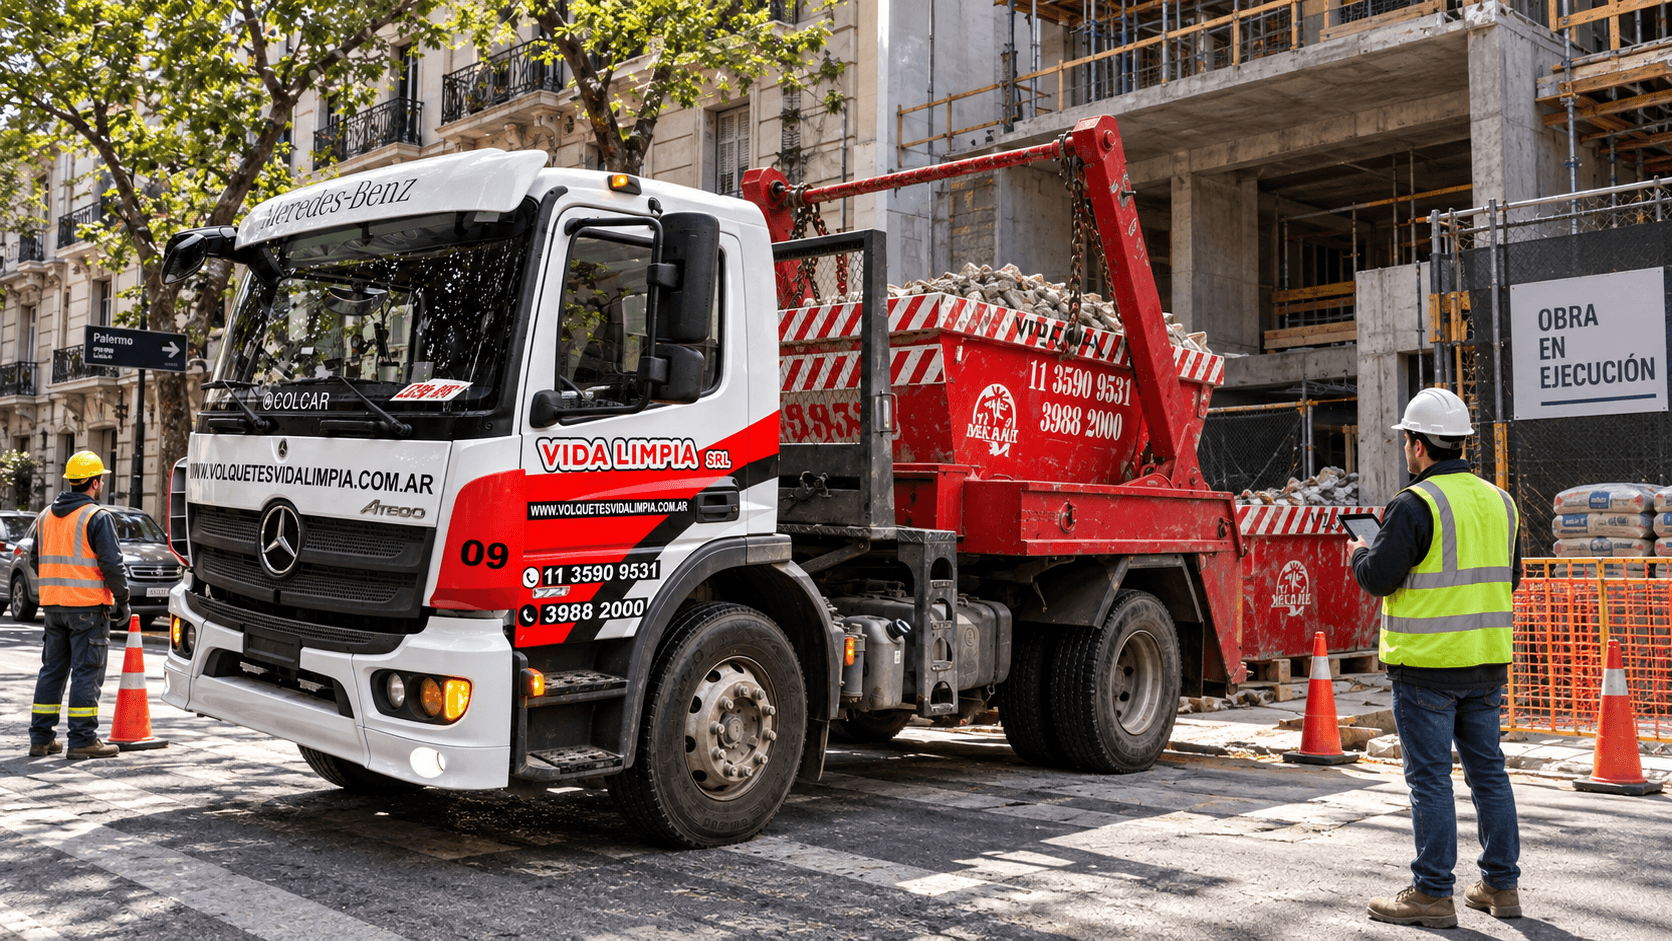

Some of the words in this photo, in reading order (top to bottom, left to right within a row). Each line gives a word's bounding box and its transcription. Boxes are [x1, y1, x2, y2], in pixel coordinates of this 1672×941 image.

[260, 178, 418, 229] Mercedes-Benz
[1538, 303, 1599, 332] OBRA
[93, 332, 134, 346] Palermo
[1539, 336, 1566, 361] EN
[1028, 359, 1047, 392] 11
[1052, 364, 1093, 400] 3590
[1096, 372, 1132, 407] 9531
[1540, 353, 1656, 389] EJECUCIÓN
[1040, 401, 1082, 436] 3988
[1084, 408, 1123, 441] 2000
[542, 443, 609, 466] VIDA
[616, 443, 696, 466] LIMPIA
[707, 453, 730, 467] SRL
[530, 502, 688, 517] WWW.VOLQUETESVIDALIMPIA.COM.AR
[460, 539, 509, 570] 09
[544, 567, 564, 585] 11
[570, 564, 614, 583] 3590
[618, 561, 658, 579] 9531
[545, 603, 593, 623] 3988
[598, 599, 645, 619] 2000
